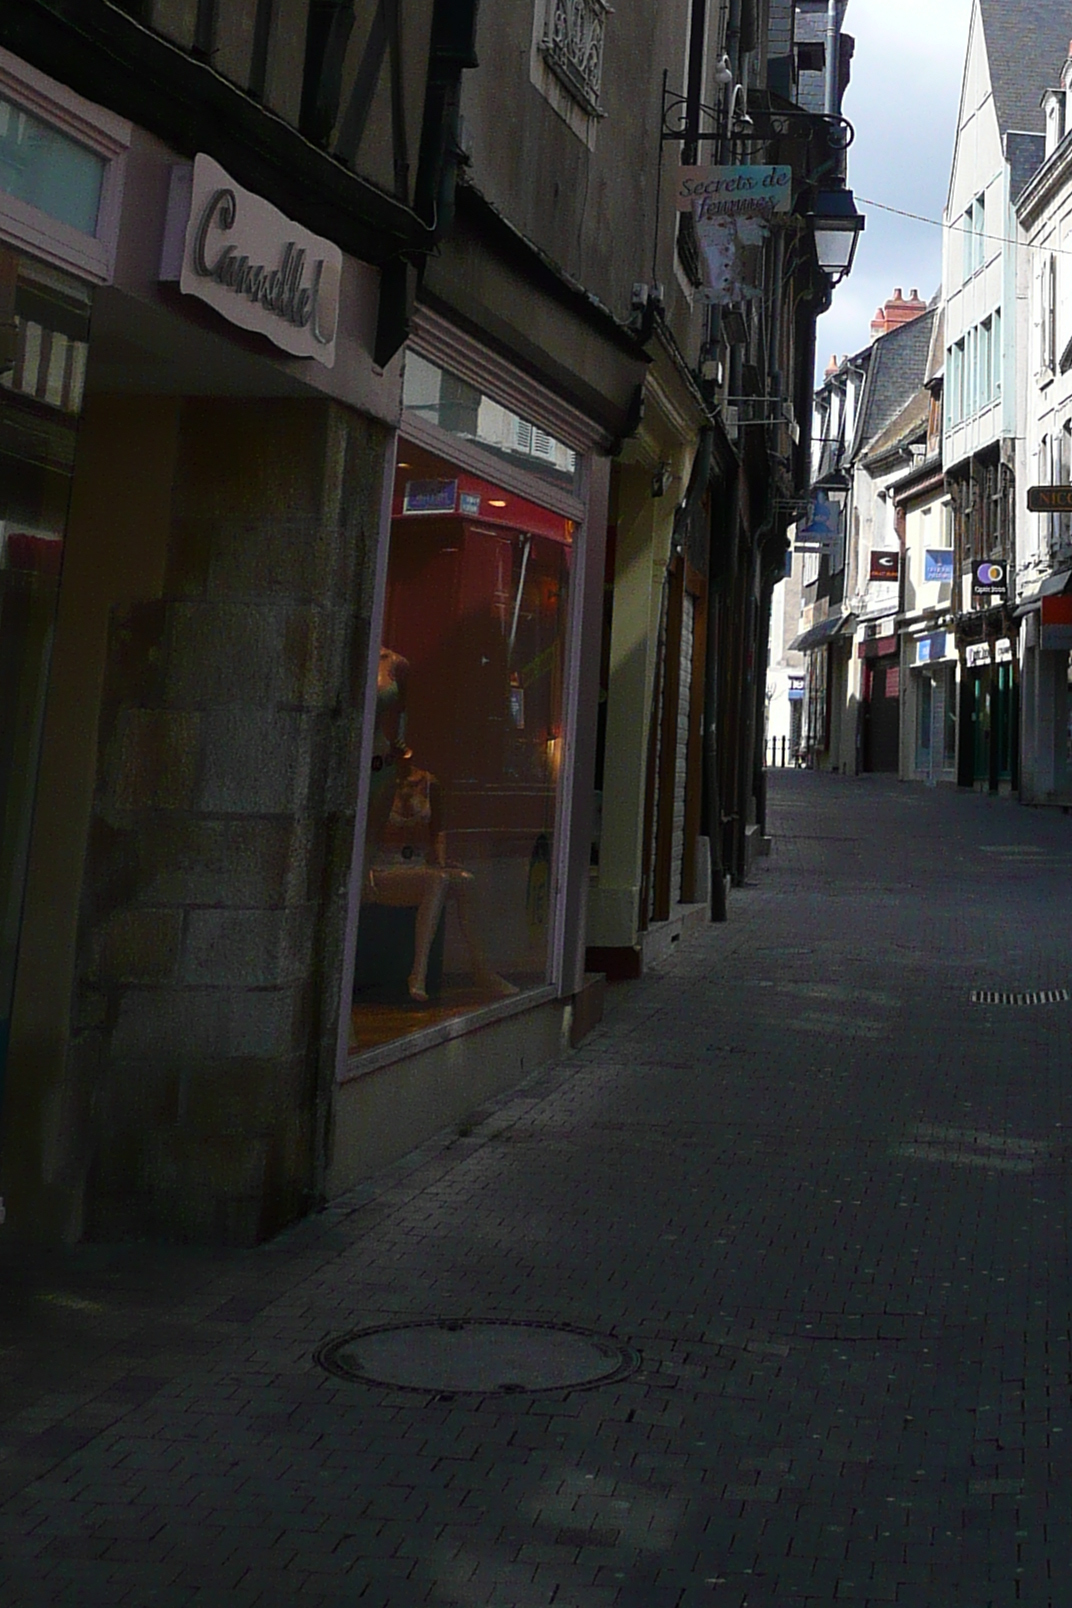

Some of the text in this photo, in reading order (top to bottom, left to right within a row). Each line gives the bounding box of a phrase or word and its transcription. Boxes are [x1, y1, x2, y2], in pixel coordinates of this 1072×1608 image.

[680, 167, 790, 198] Secrets de
[697, 195, 781, 222] femmes
